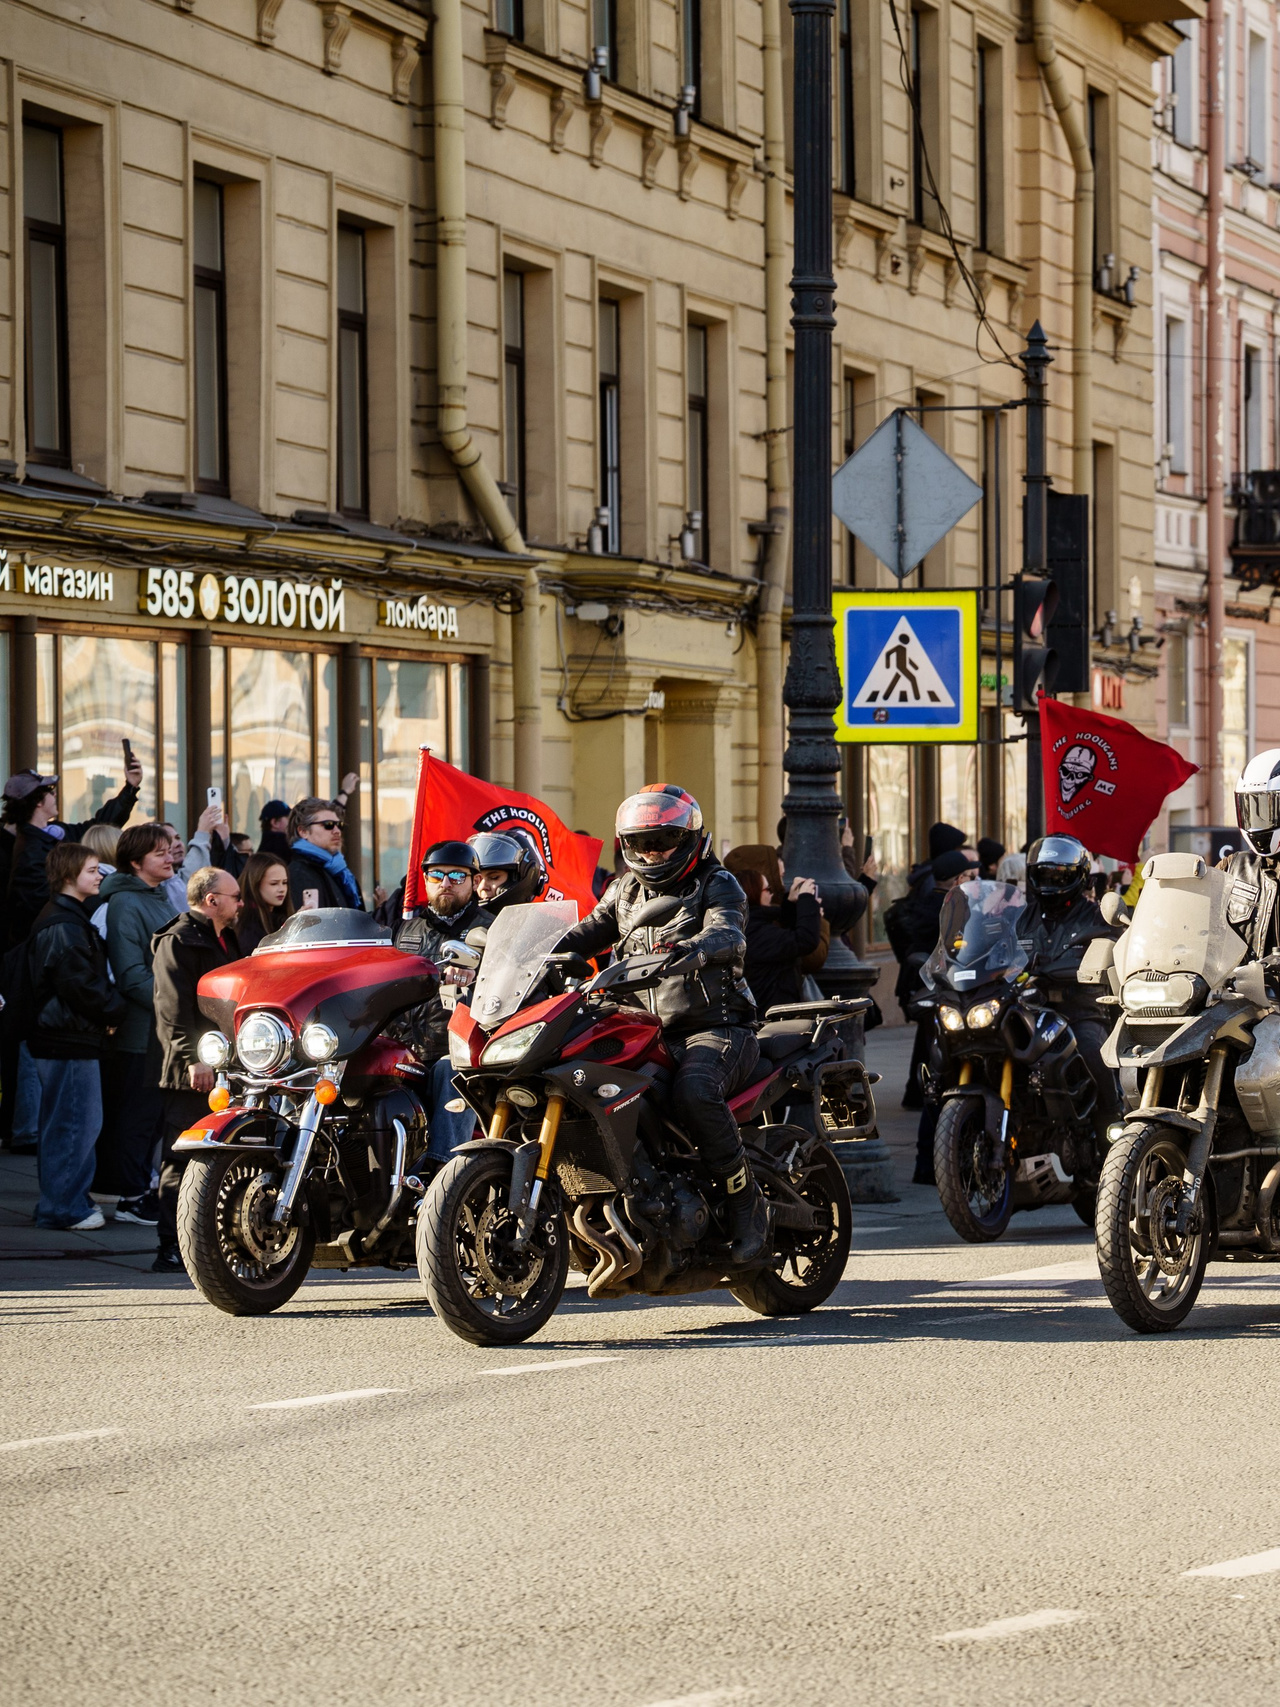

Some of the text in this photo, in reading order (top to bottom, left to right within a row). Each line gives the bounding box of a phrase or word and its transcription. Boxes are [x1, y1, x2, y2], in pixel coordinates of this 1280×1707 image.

[23, 563, 114, 602] магазин
[146, 567, 346, 632] 585 ЗОЛОТОЙ
[385, 595, 459, 640] ломбард
[1075, 732, 1119, 771] HOOLIGANS
[1096, 782, 1114, 794] MC
[482, 807, 553, 863] THE HOOLIGANS
